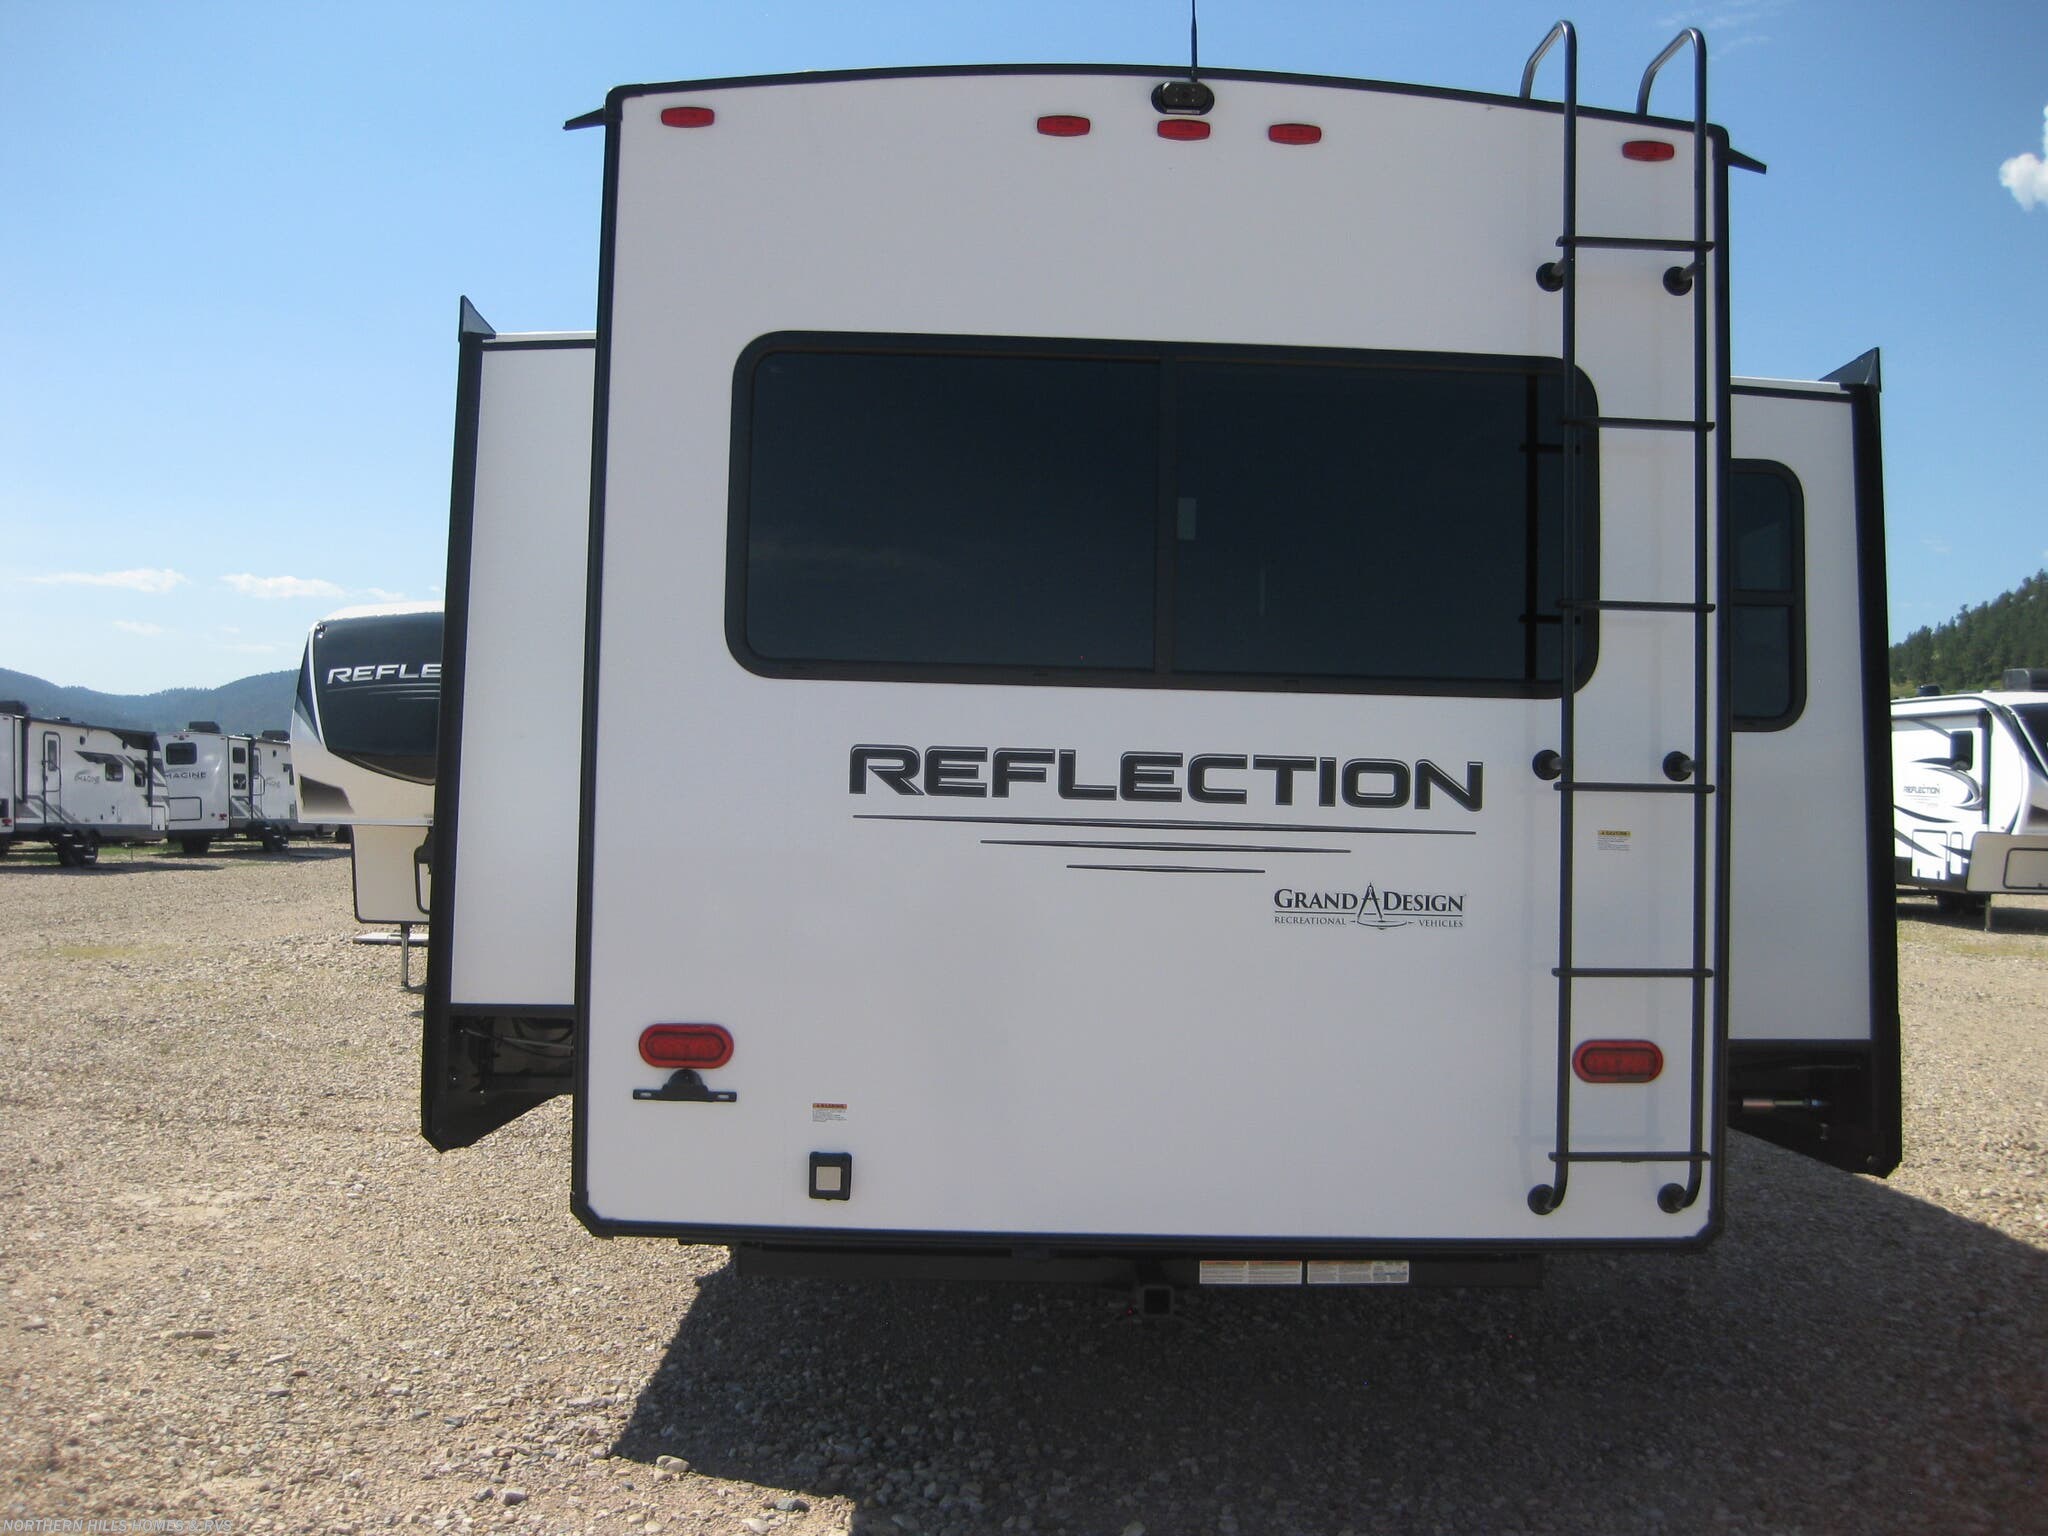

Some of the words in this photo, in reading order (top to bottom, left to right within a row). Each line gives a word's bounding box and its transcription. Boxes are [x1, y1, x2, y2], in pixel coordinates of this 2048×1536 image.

[848, 743, 1484, 813] REFLECTION
[1273, 888, 1358, 910] GRAND
[1383, 891, 1464, 912] DESIGN
[1274, 916, 1346, 926] RECREATIONAL
[1418, 919, 1464, 928] VEHICLES
